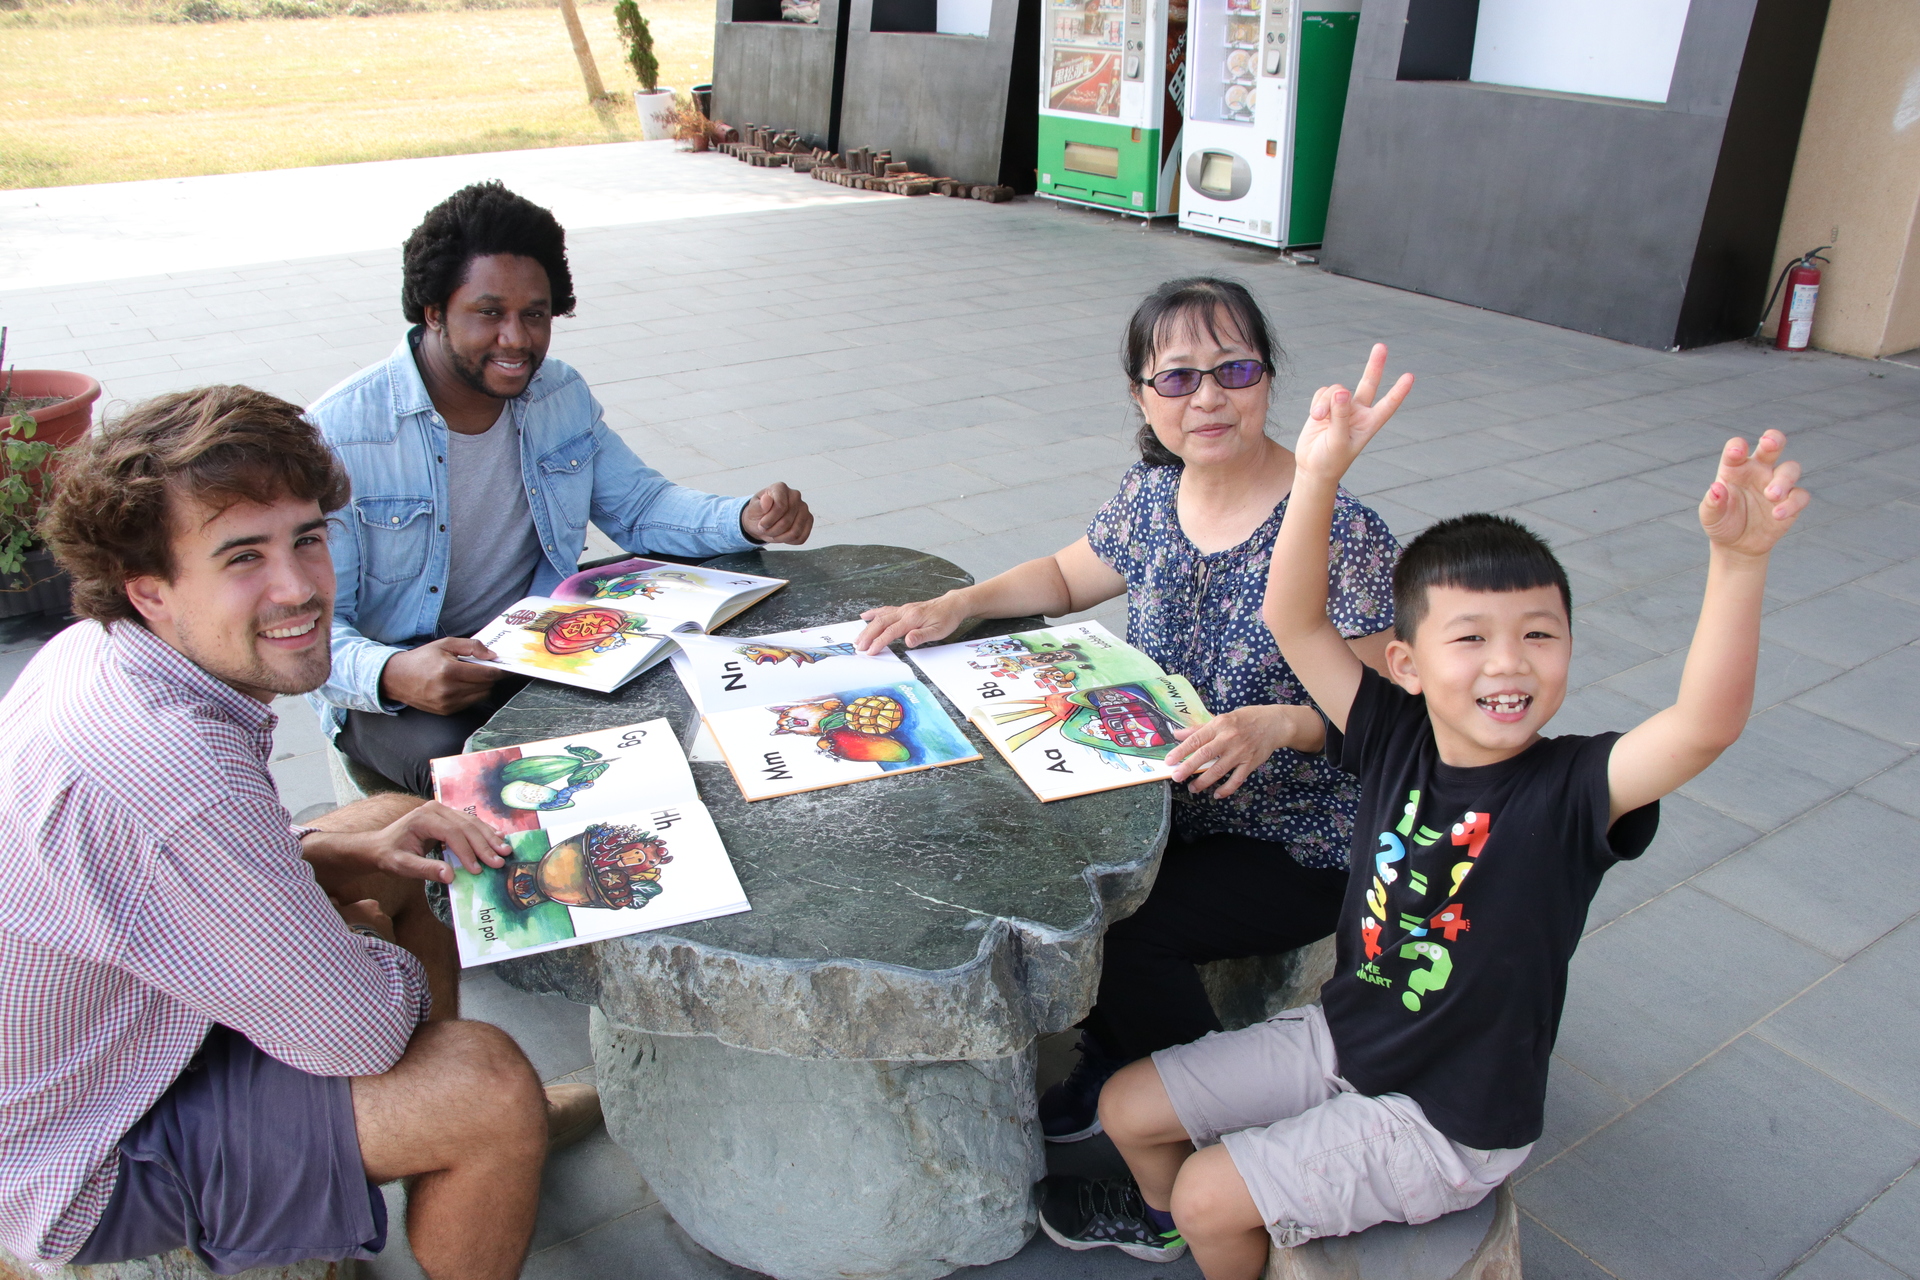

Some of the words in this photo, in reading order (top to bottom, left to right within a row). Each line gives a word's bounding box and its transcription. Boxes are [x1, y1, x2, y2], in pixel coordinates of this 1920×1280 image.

[484, 630, 511, 648] lanter
[721, 661, 747, 692] Nn
[898, 684, 920, 704] mango
[976, 681, 1006, 699] Bb
[1174, 701, 1192, 715] Ali
[617, 730, 648, 749] Gg
[763, 751, 793, 781] Mm
[1046, 748, 1074, 775] Aa
[650, 808, 682, 831] Hh
[479, 907, 496, 923] hot
[478, 925, 499, 942] pot
